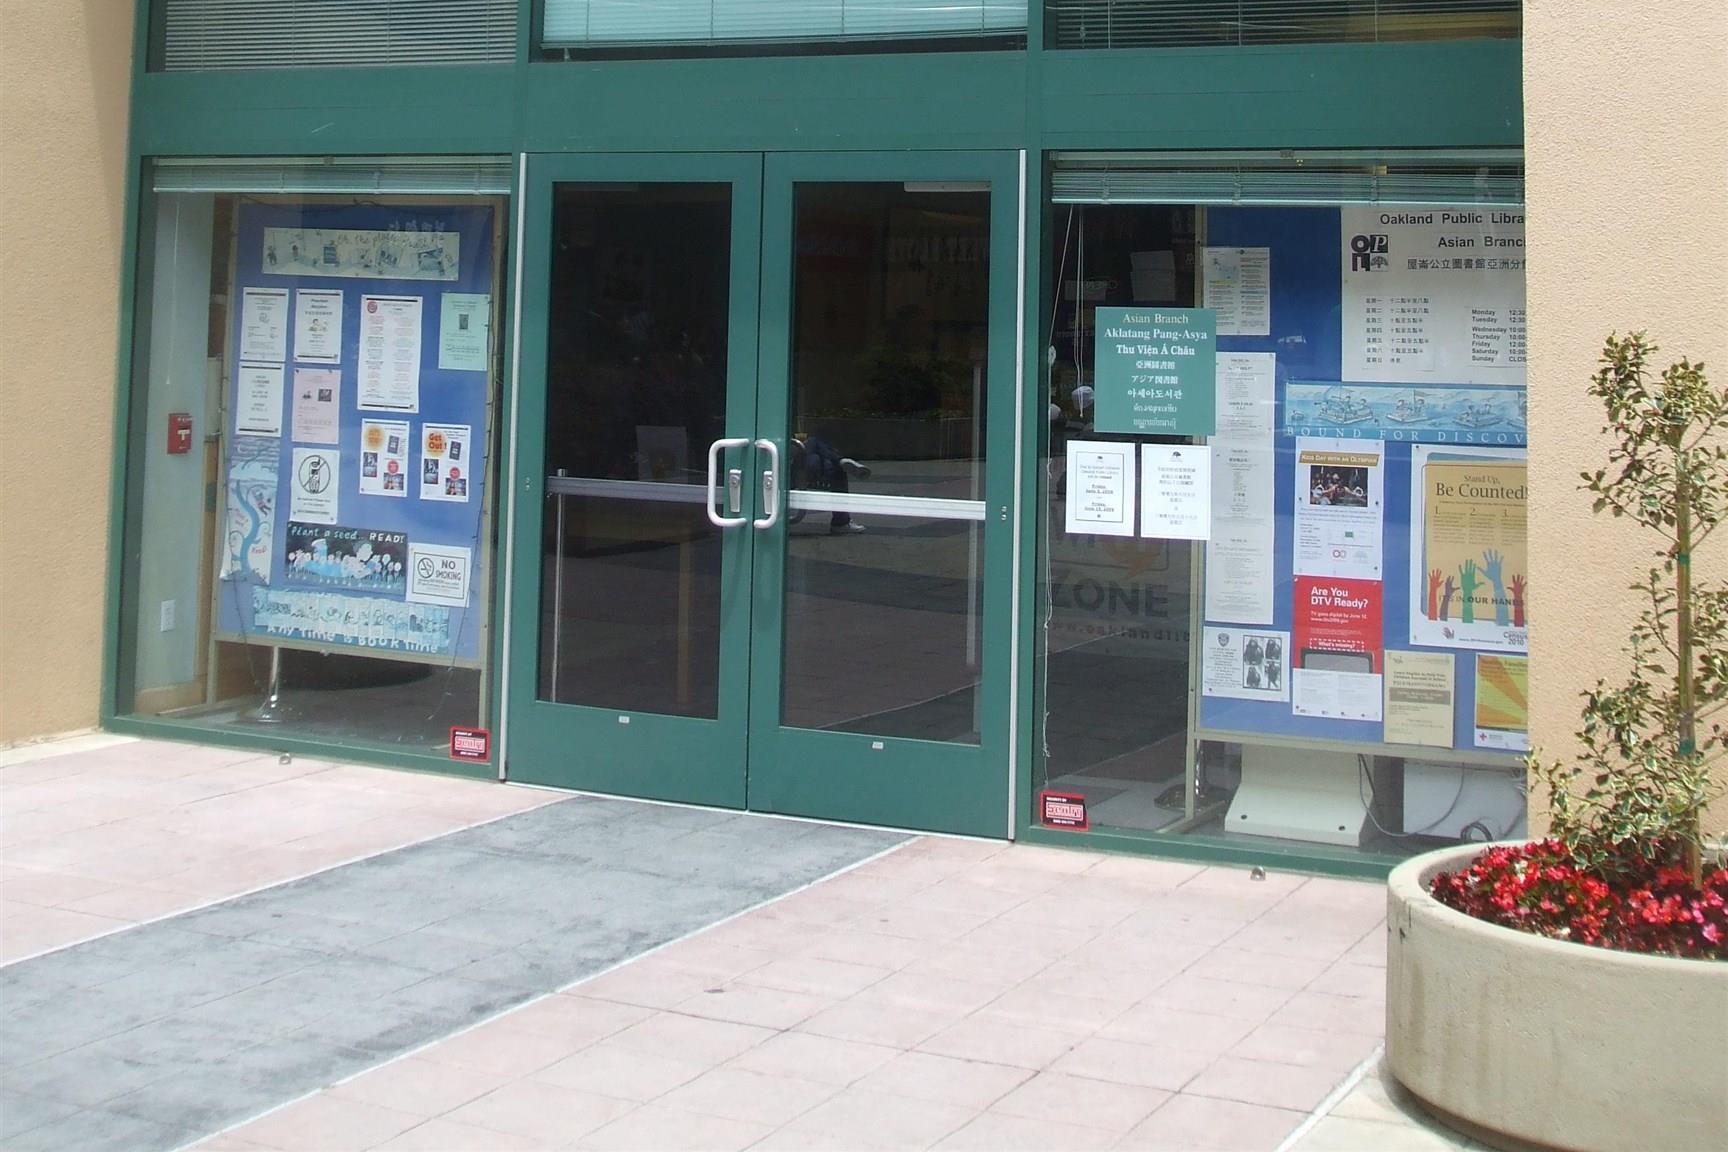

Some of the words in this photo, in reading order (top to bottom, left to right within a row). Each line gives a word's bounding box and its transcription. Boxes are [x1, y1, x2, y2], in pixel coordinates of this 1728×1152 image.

[1380, 213, 1433, 225] Oakland
[1442, 212, 1483, 224] Public
[1438, 236, 1474, 248] Asian
[1123, 313, 1150, 323] Asian
[1154, 313, 1189, 324] Branch
[1104, 328, 1150, 340] Aklatang
[1153, 328, 1208, 341] Pang-Asya
[1472, 333, 1500, 341] Thursday
[1472, 355, 1494, 363] Sunday
[1286, 426, 1362, 438] BOUND
[1379, 429, 1420, 441] FOR
[1463, 474, 1485, 483] Stand
[1436, 482, 1454, 496] Be
[441, 560, 456, 569] NO
[1310, 586, 1328, 596] Are
[1331, 587, 1349, 597] You
[1310, 596, 1332, 606] DTV
[1334, 598, 1369, 609] Ready?
[1467, 595, 1488, 605] OUR
